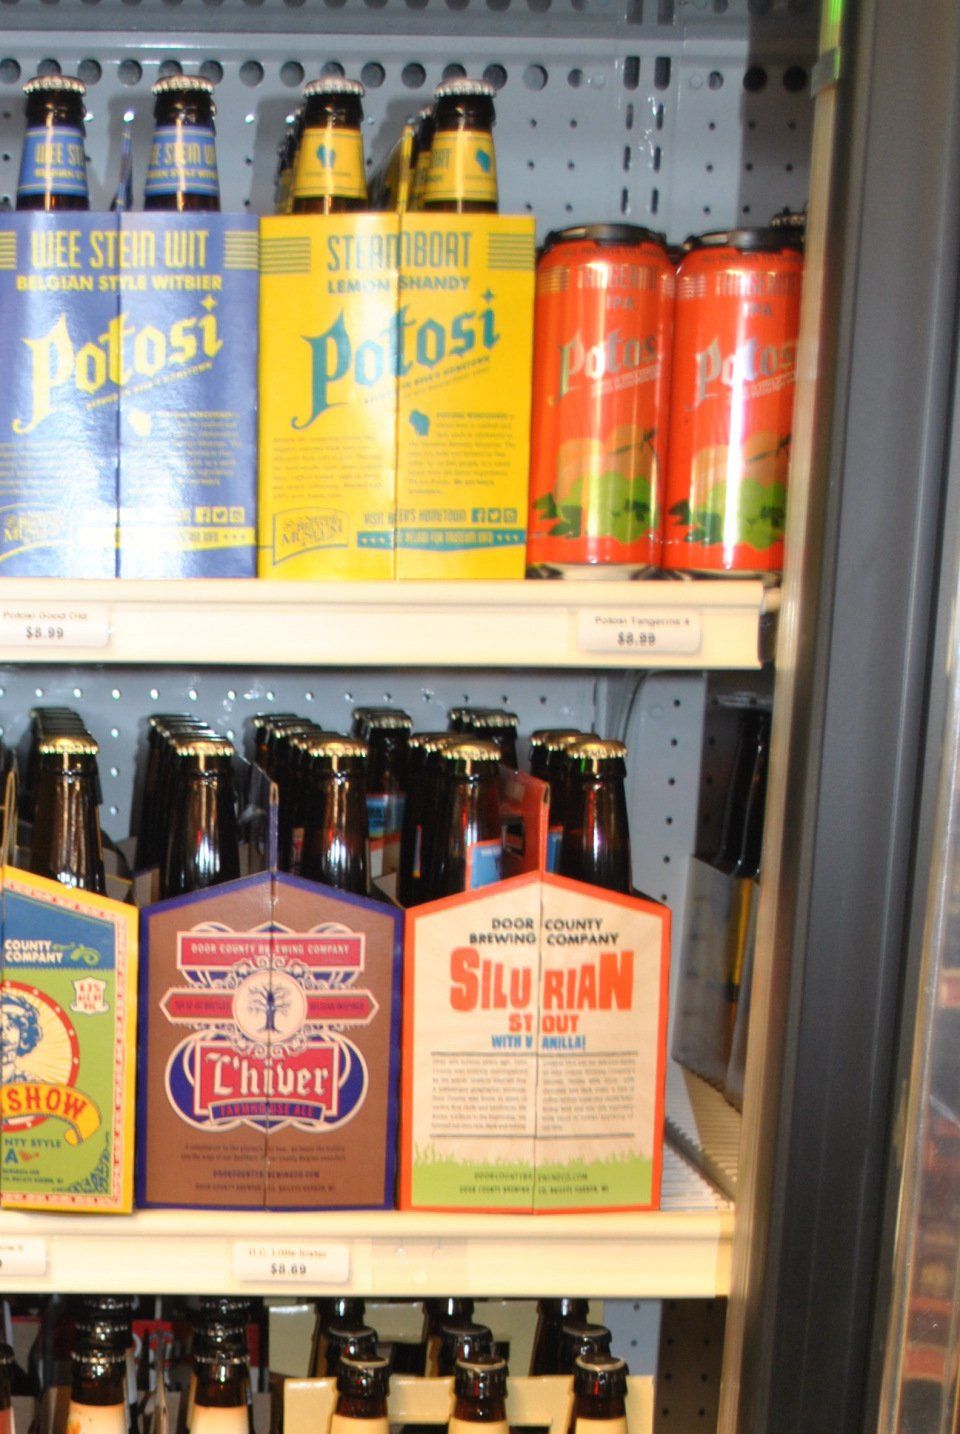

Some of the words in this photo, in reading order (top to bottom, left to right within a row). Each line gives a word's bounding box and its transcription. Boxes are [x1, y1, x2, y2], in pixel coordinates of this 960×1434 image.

[31, 230, 83, 269] WEE
[89, 230, 159, 269] STEIN
[164, 231, 211, 269] WIT
[327, 232, 473, 272] STEAMBOAT
[16, 275, 93, 292] BELGIAN
[98, 275, 148, 292] STYLE
[152, 275, 223, 292] WITBIER
[328, 277, 391, 295] LEMON
[399, 276, 471, 293] SHANDY
[12, 295, 224, 435] Potosi
[290, 289, 501, 430] Potosi
[26, 626, 64, 639] $8.99
[491, 918, 535, 930] DOOR
[545, 918, 603, 931] COUNTY
[4, 940, 52, 952] COUNTY
[469, 932, 536, 945] BREWING
[546, 932, 620, 945] COMPANY
[5, 952, 64, 964] COMPANY
[449, 946, 635, 1012] SILURIAN
[508, 1013, 580, 1034] STOUT
[491, 1034, 522, 1049] WITH
[523, 1035, 587, 1050] VANILLA!
[204, 1051, 330, 1097] L'hiver
